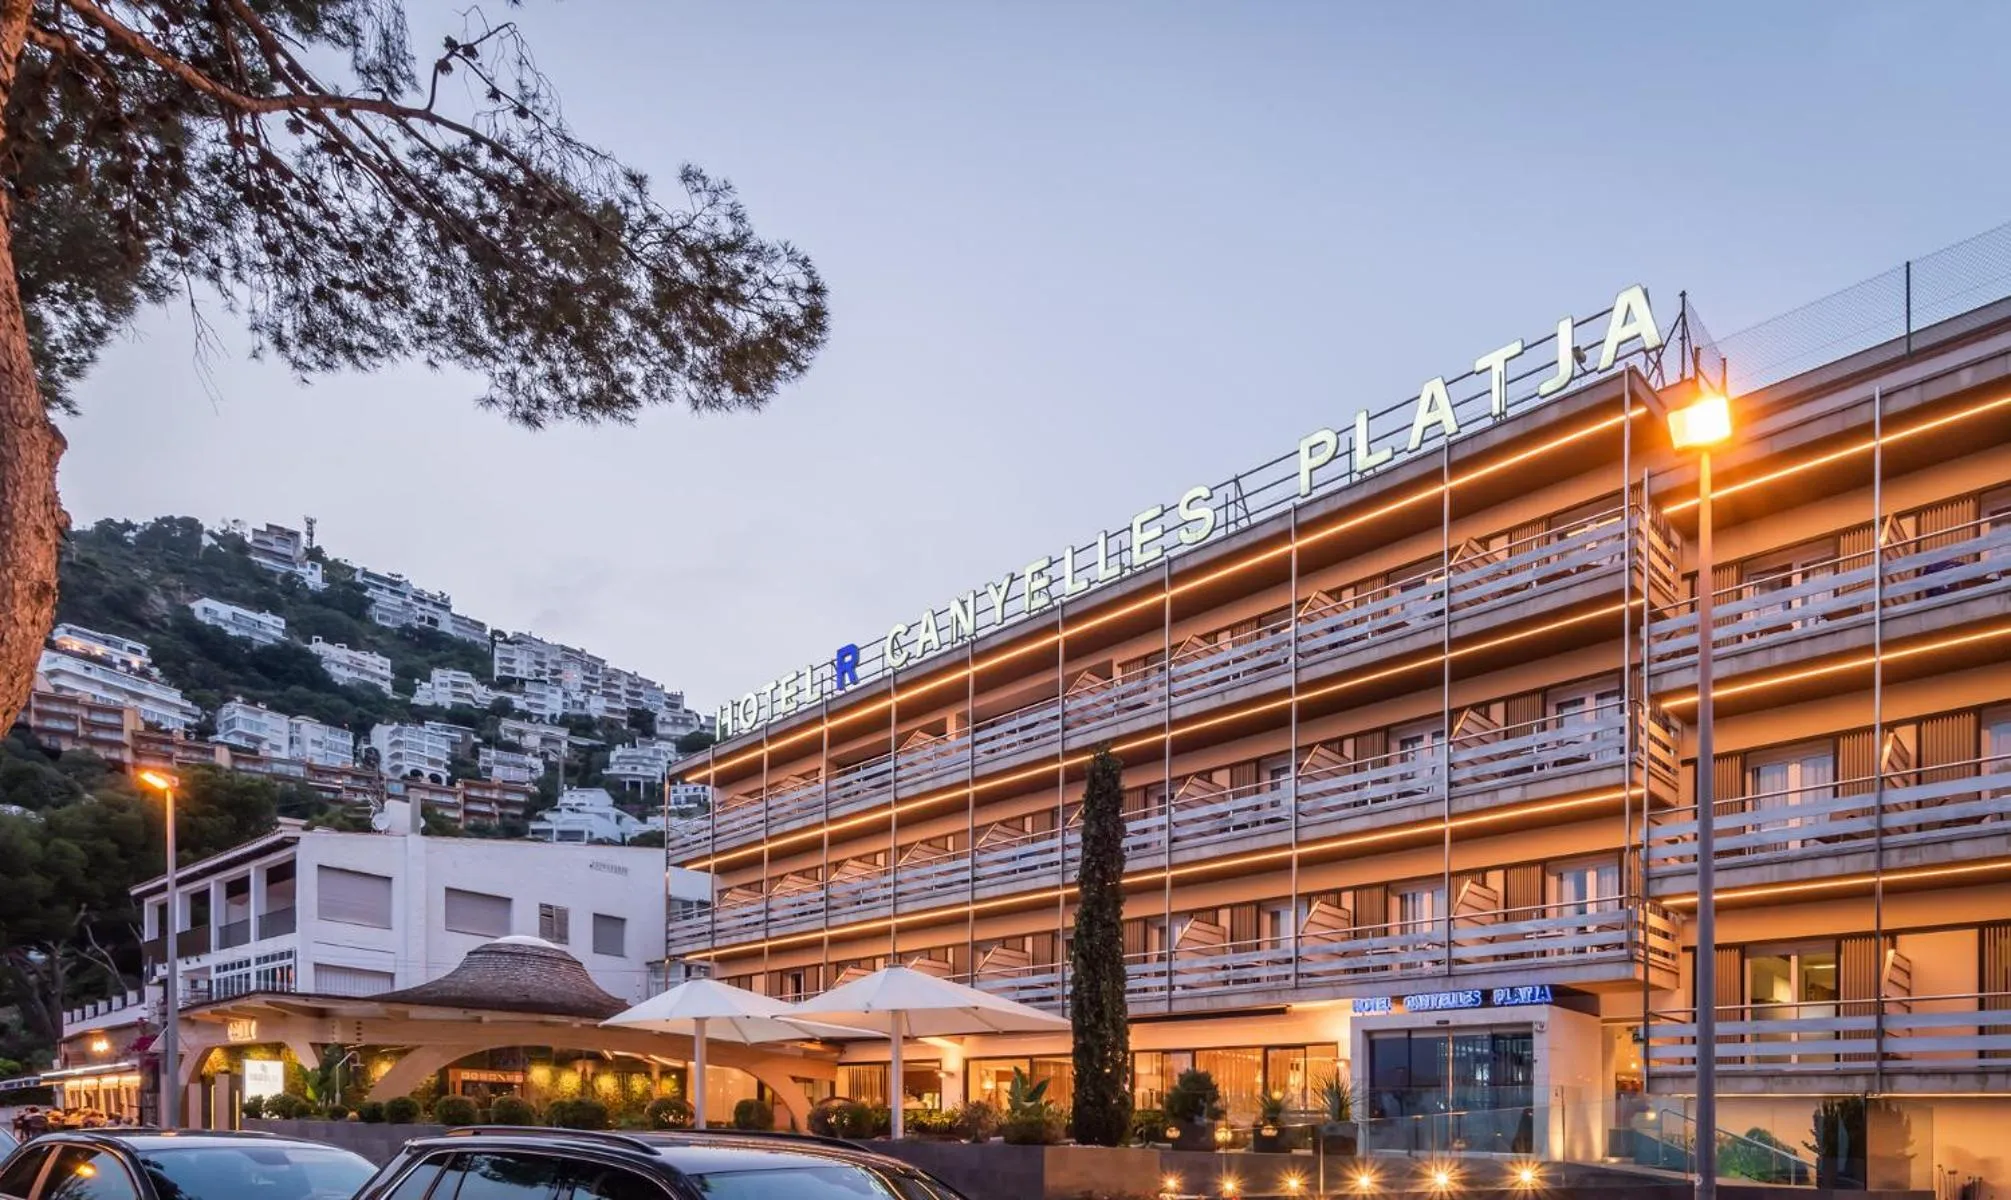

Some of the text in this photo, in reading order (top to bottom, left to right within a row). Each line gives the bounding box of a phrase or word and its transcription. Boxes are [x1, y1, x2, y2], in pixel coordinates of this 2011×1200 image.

[716, 284, 1663, 742] HOTEL R CANYELLES PLATJA
[1352, 997, 1391, 1014] HOTEL
[1493, 984, 1552, 1004] PLATJA
